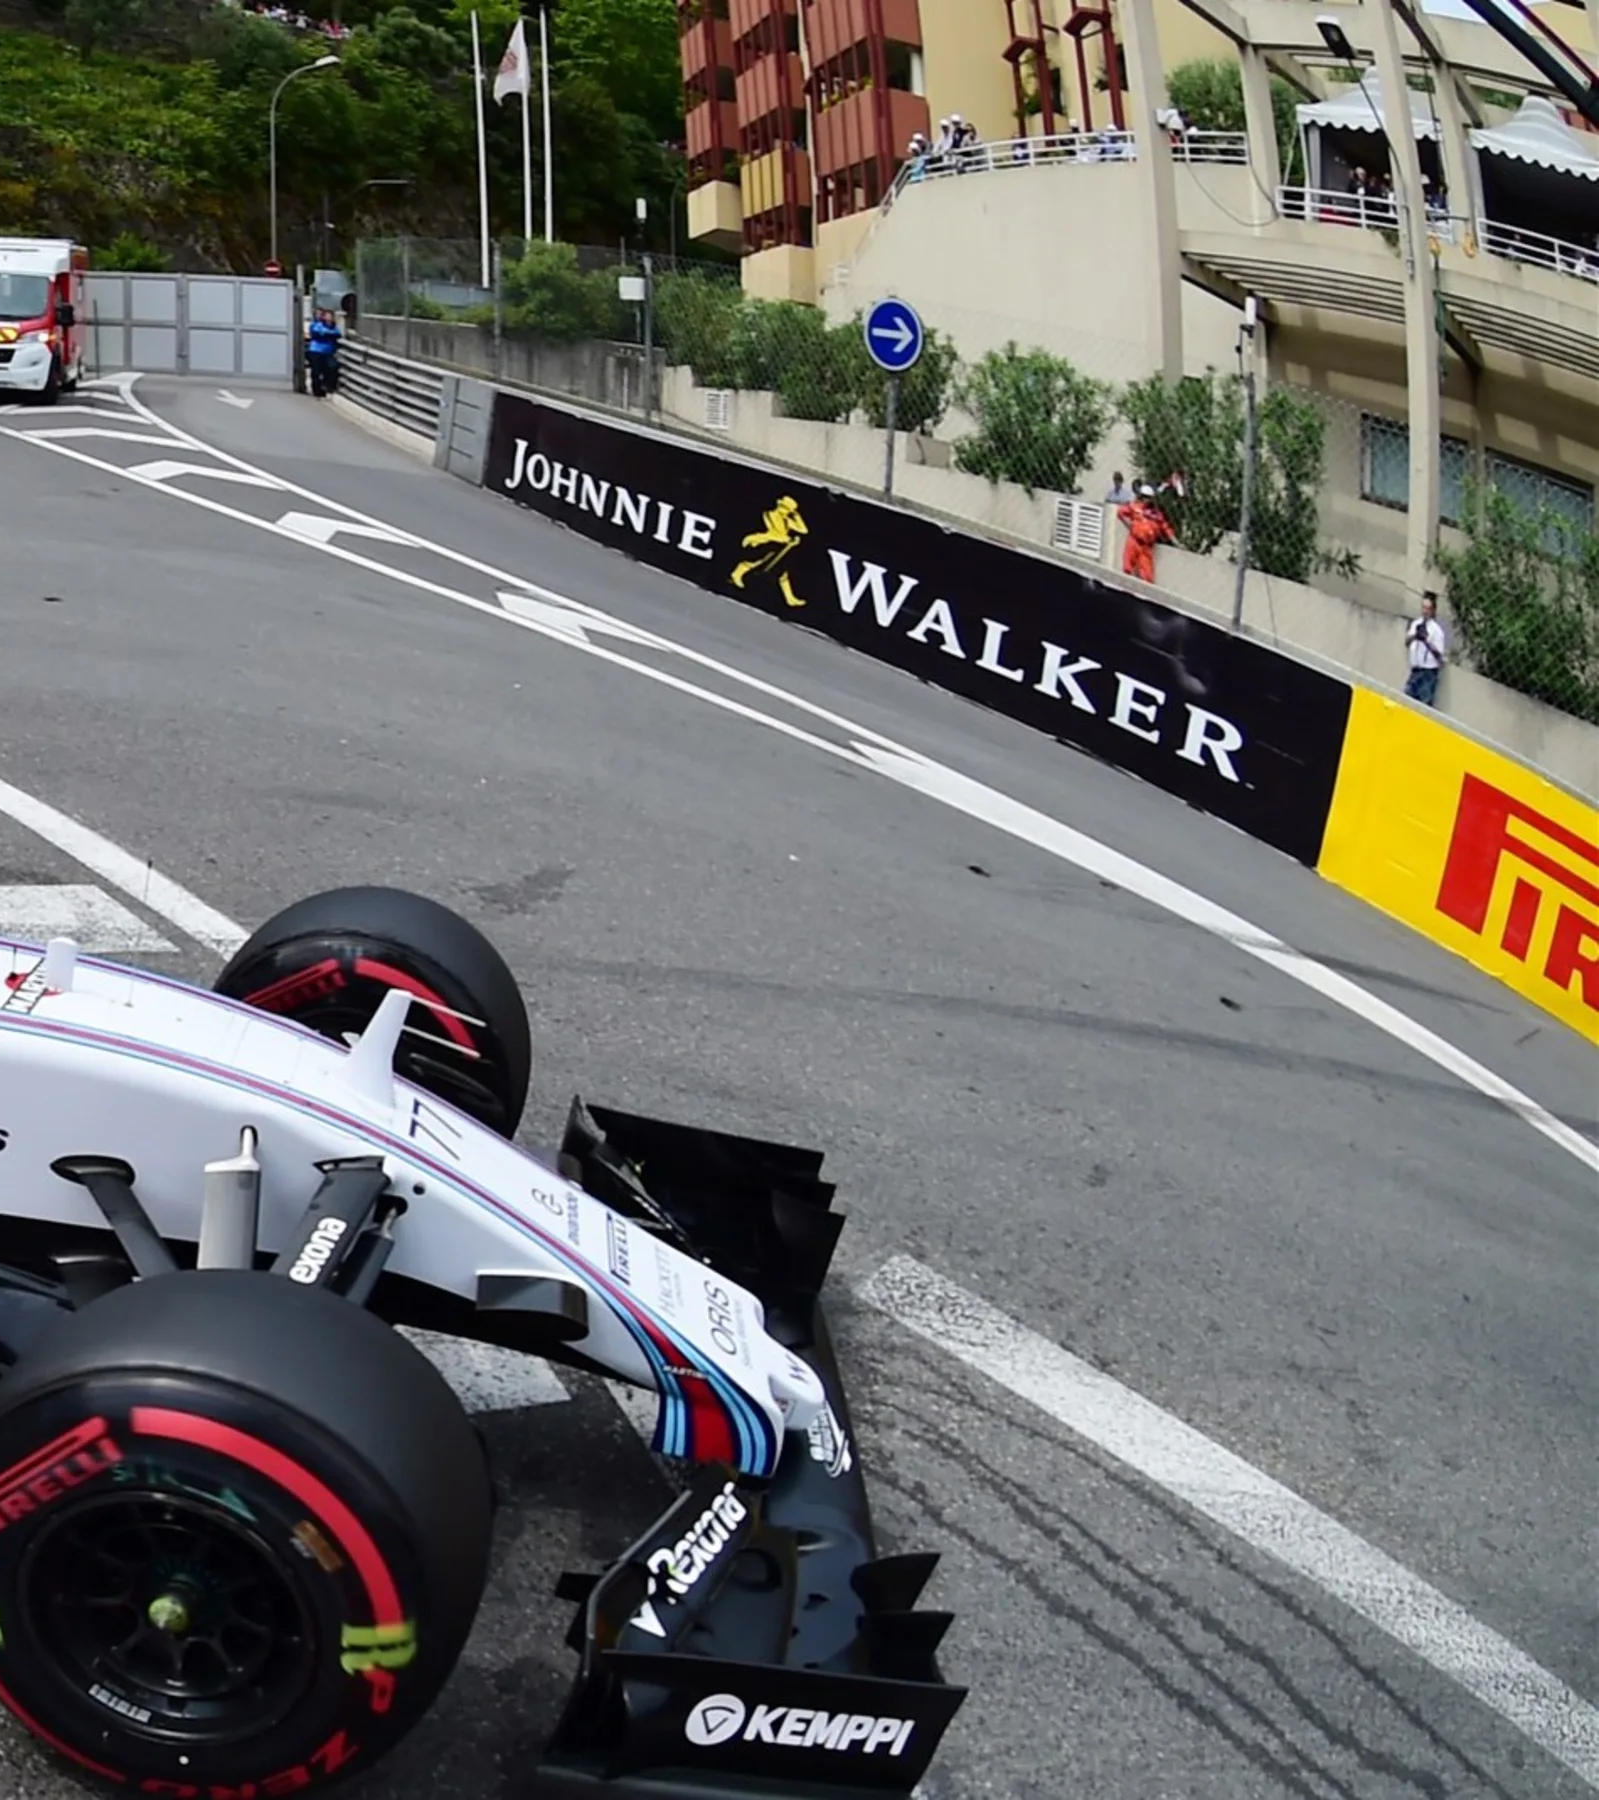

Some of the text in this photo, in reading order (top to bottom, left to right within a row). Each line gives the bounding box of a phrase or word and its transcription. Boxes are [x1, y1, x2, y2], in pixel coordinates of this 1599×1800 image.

[504, 438, 1244, 784] JOHNNIE WALKER
[606, 1211, 631, 1286] PIRELLI
[703, 1280, 737, 1356] ORIS
[743, 1705, 914, 1756] KEMPPI
